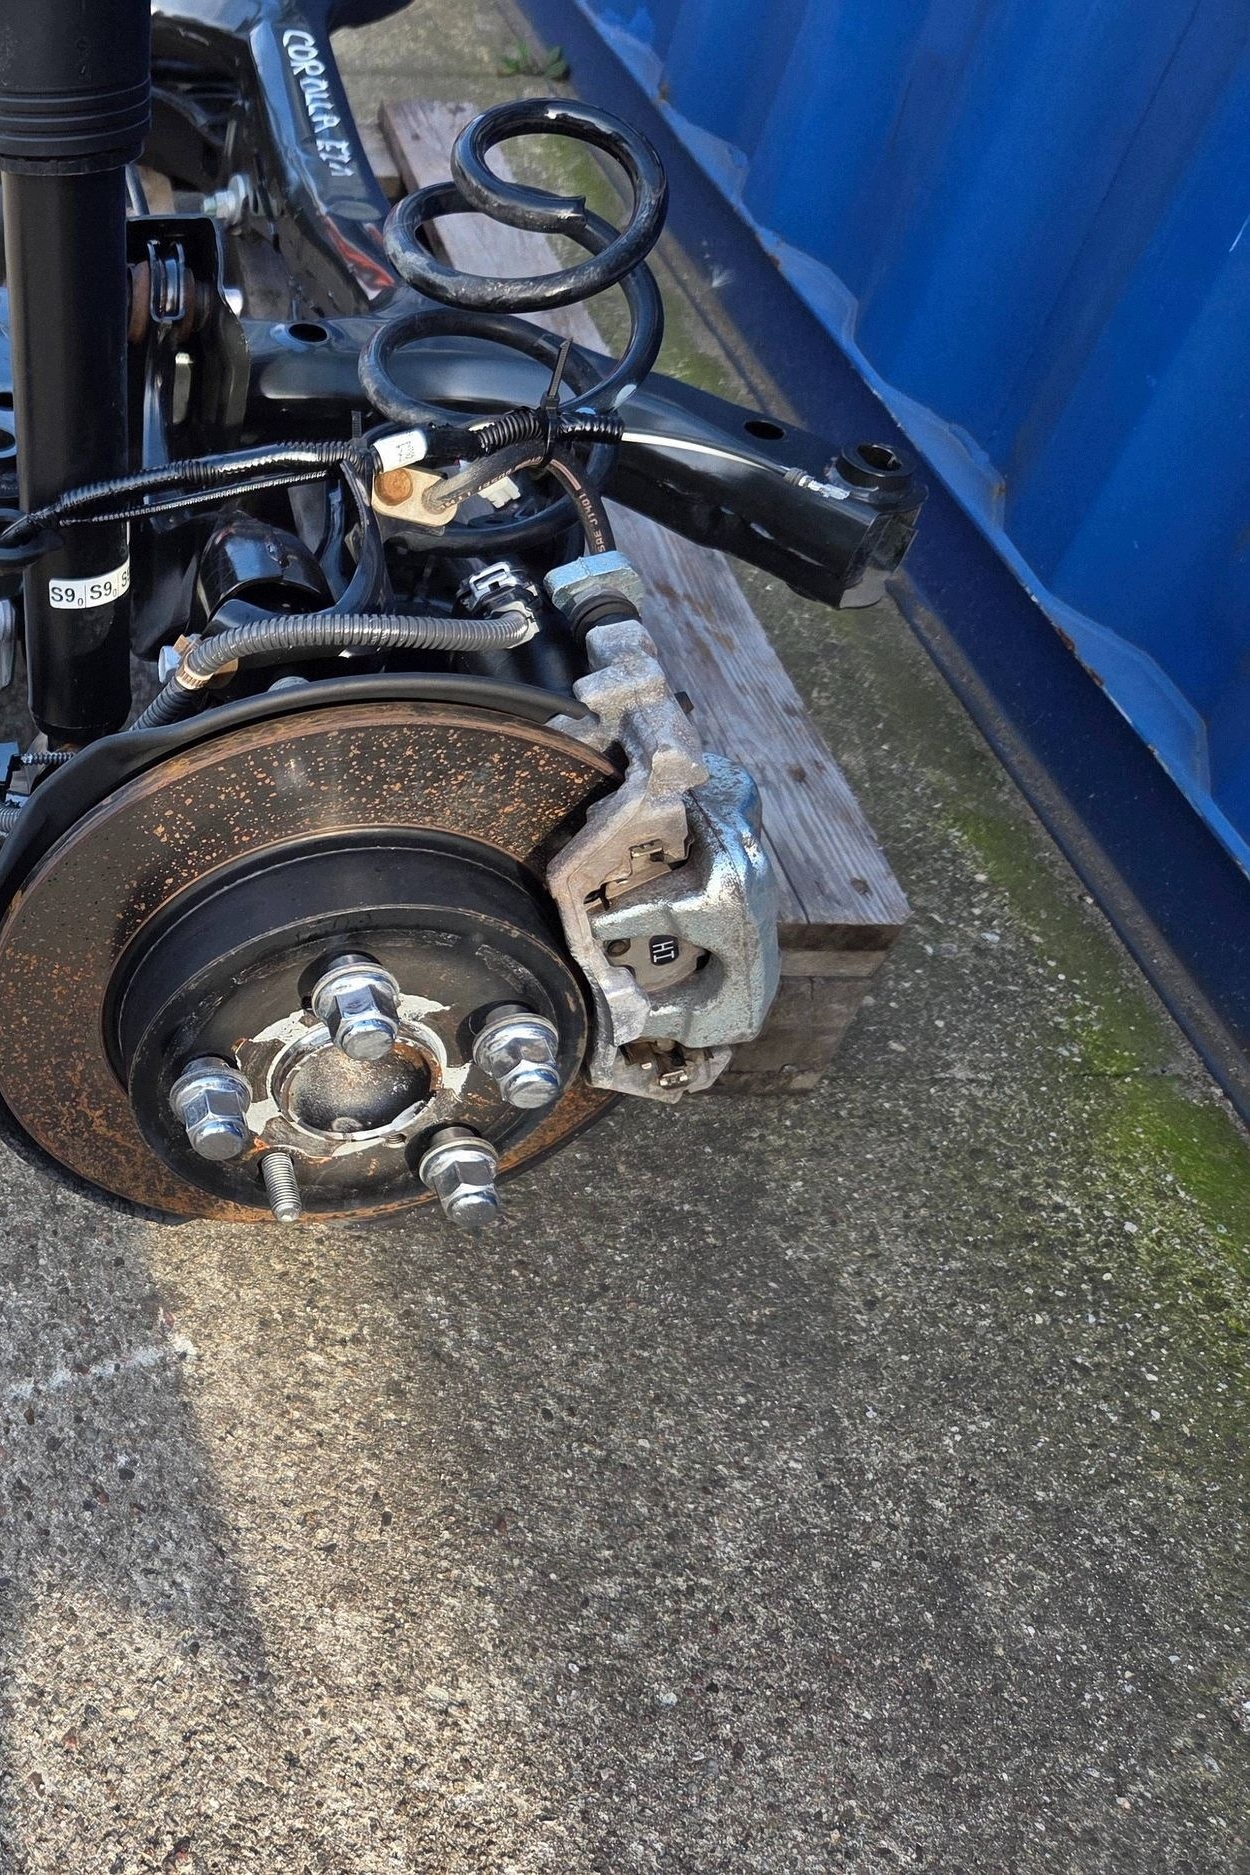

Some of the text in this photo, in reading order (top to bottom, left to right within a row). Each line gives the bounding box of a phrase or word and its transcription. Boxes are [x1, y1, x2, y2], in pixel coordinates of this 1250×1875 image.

[282, 29, 341, 134] COROLLA
[578, 493, 606, 553] SAE J1401
